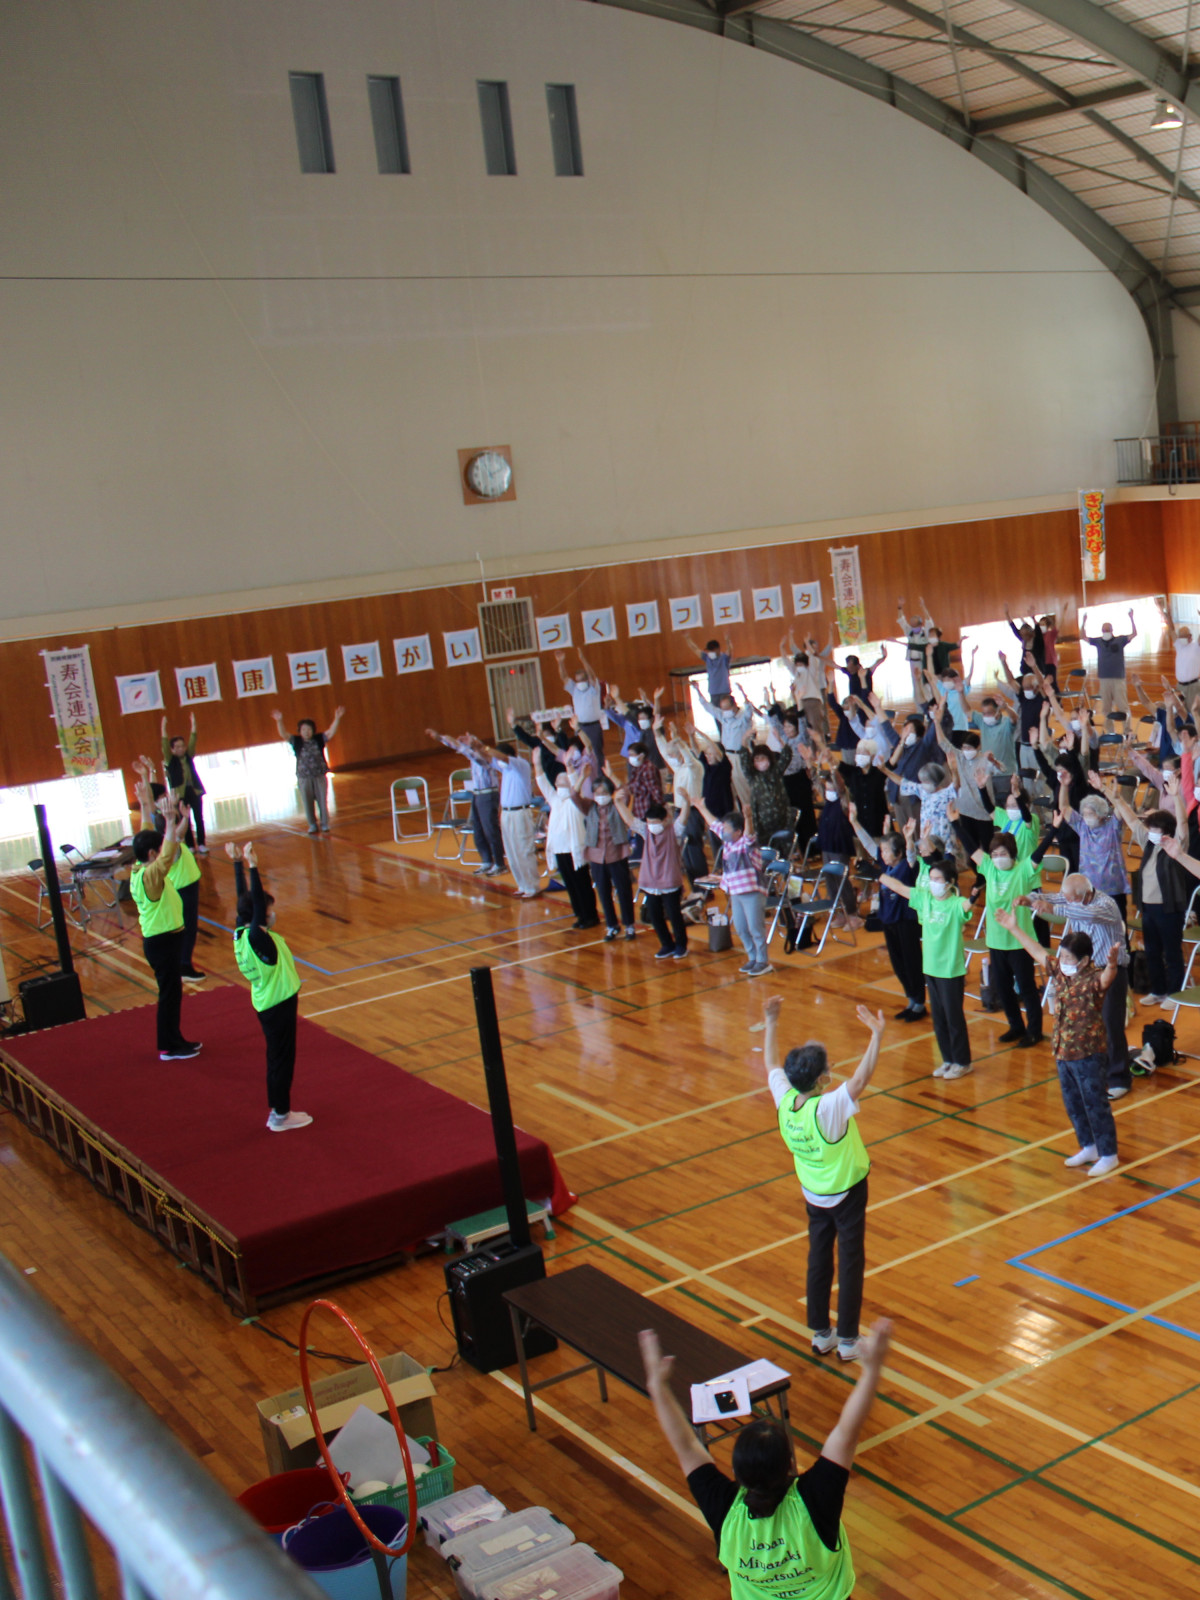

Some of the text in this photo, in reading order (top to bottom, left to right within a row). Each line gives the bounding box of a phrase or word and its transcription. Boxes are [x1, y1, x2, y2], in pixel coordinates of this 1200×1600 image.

[60, 663, 92, 754] 寿会連合会
[739, 1550, 802, 1572] Miyazaki
